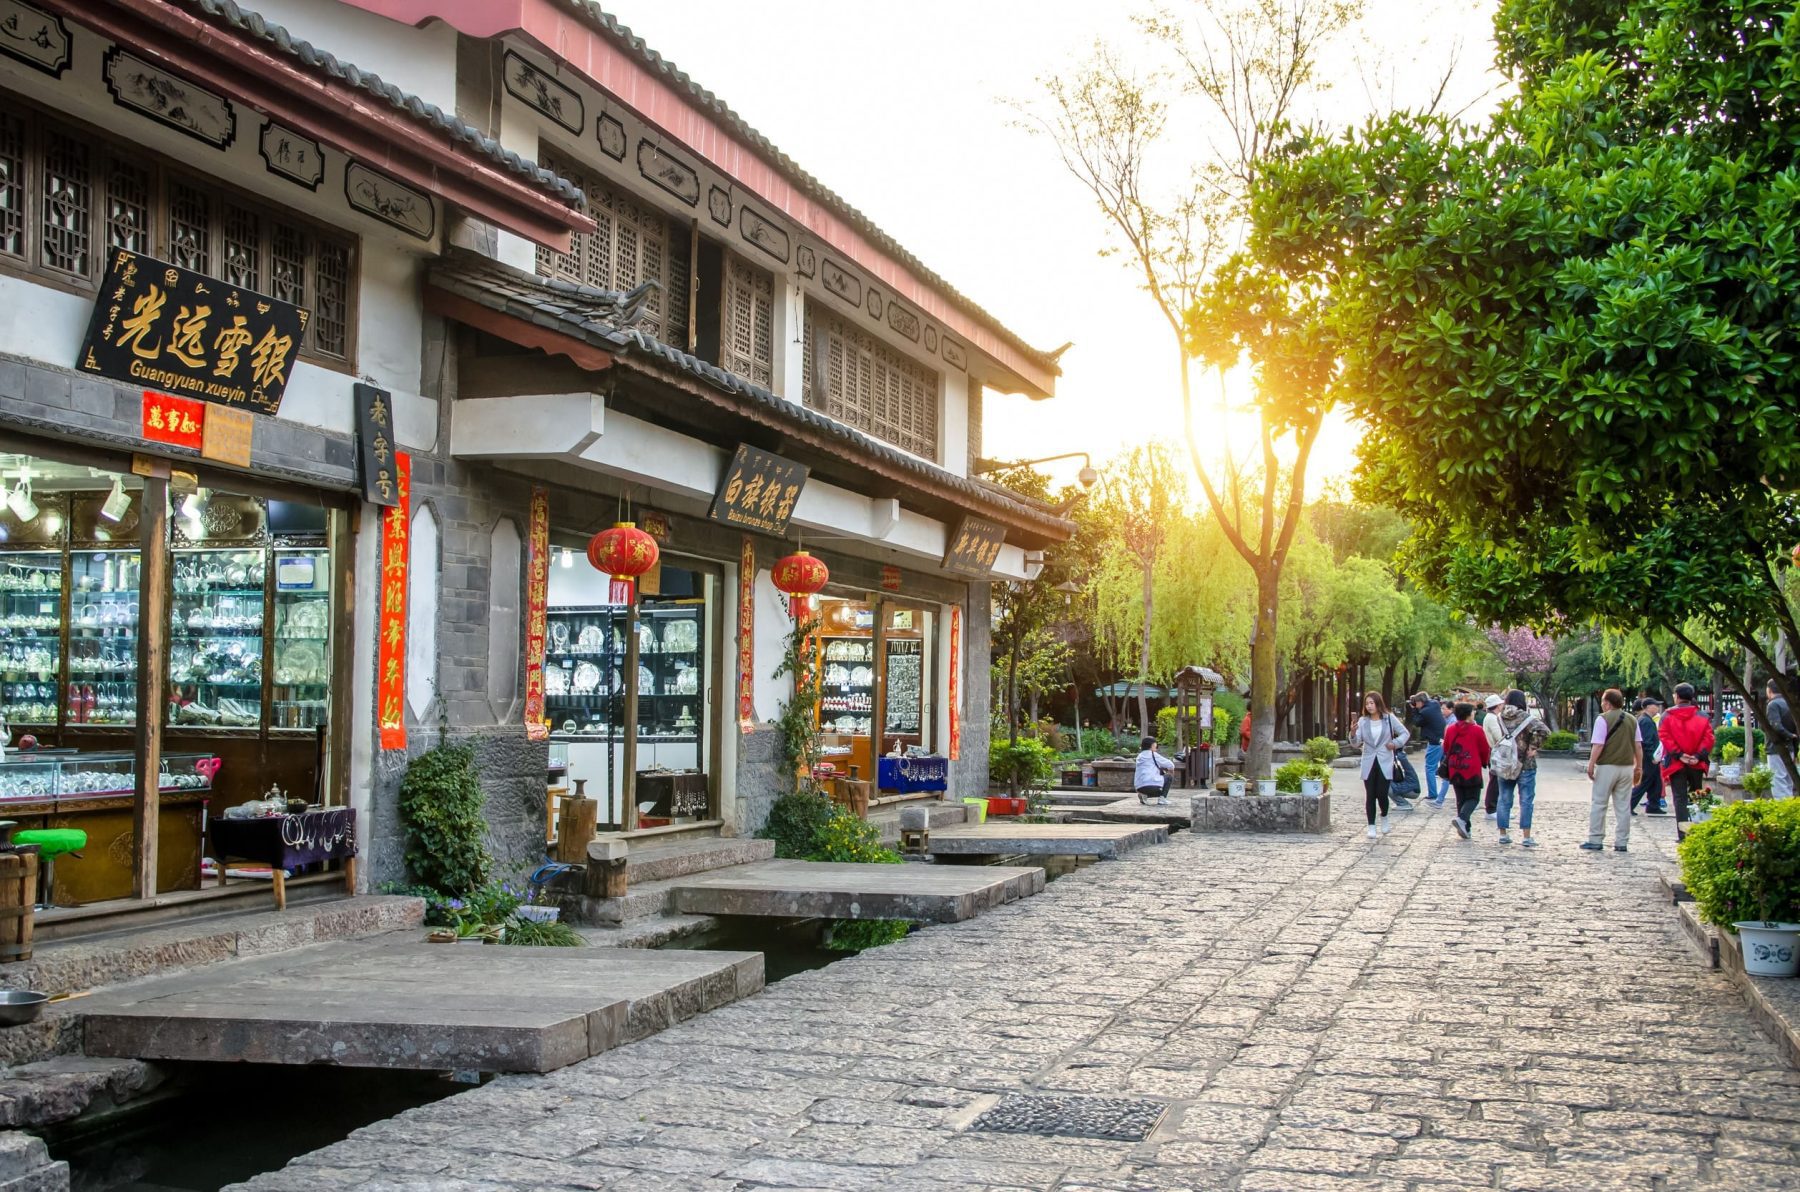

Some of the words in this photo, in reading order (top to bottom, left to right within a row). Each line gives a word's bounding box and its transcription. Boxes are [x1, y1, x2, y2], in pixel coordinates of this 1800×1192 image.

[103, 285, 126, 341] 老字号
[116, 284, 293, 388] 光远雪银
[129, 359, 204, 392] Guangyuan
[205, 383, 246, 402] xueyin
[147, 405, 202, 435] 萬事如
[369, 394, 392, 499] 老字号
[725, 468, 799, 520] 白族银器
